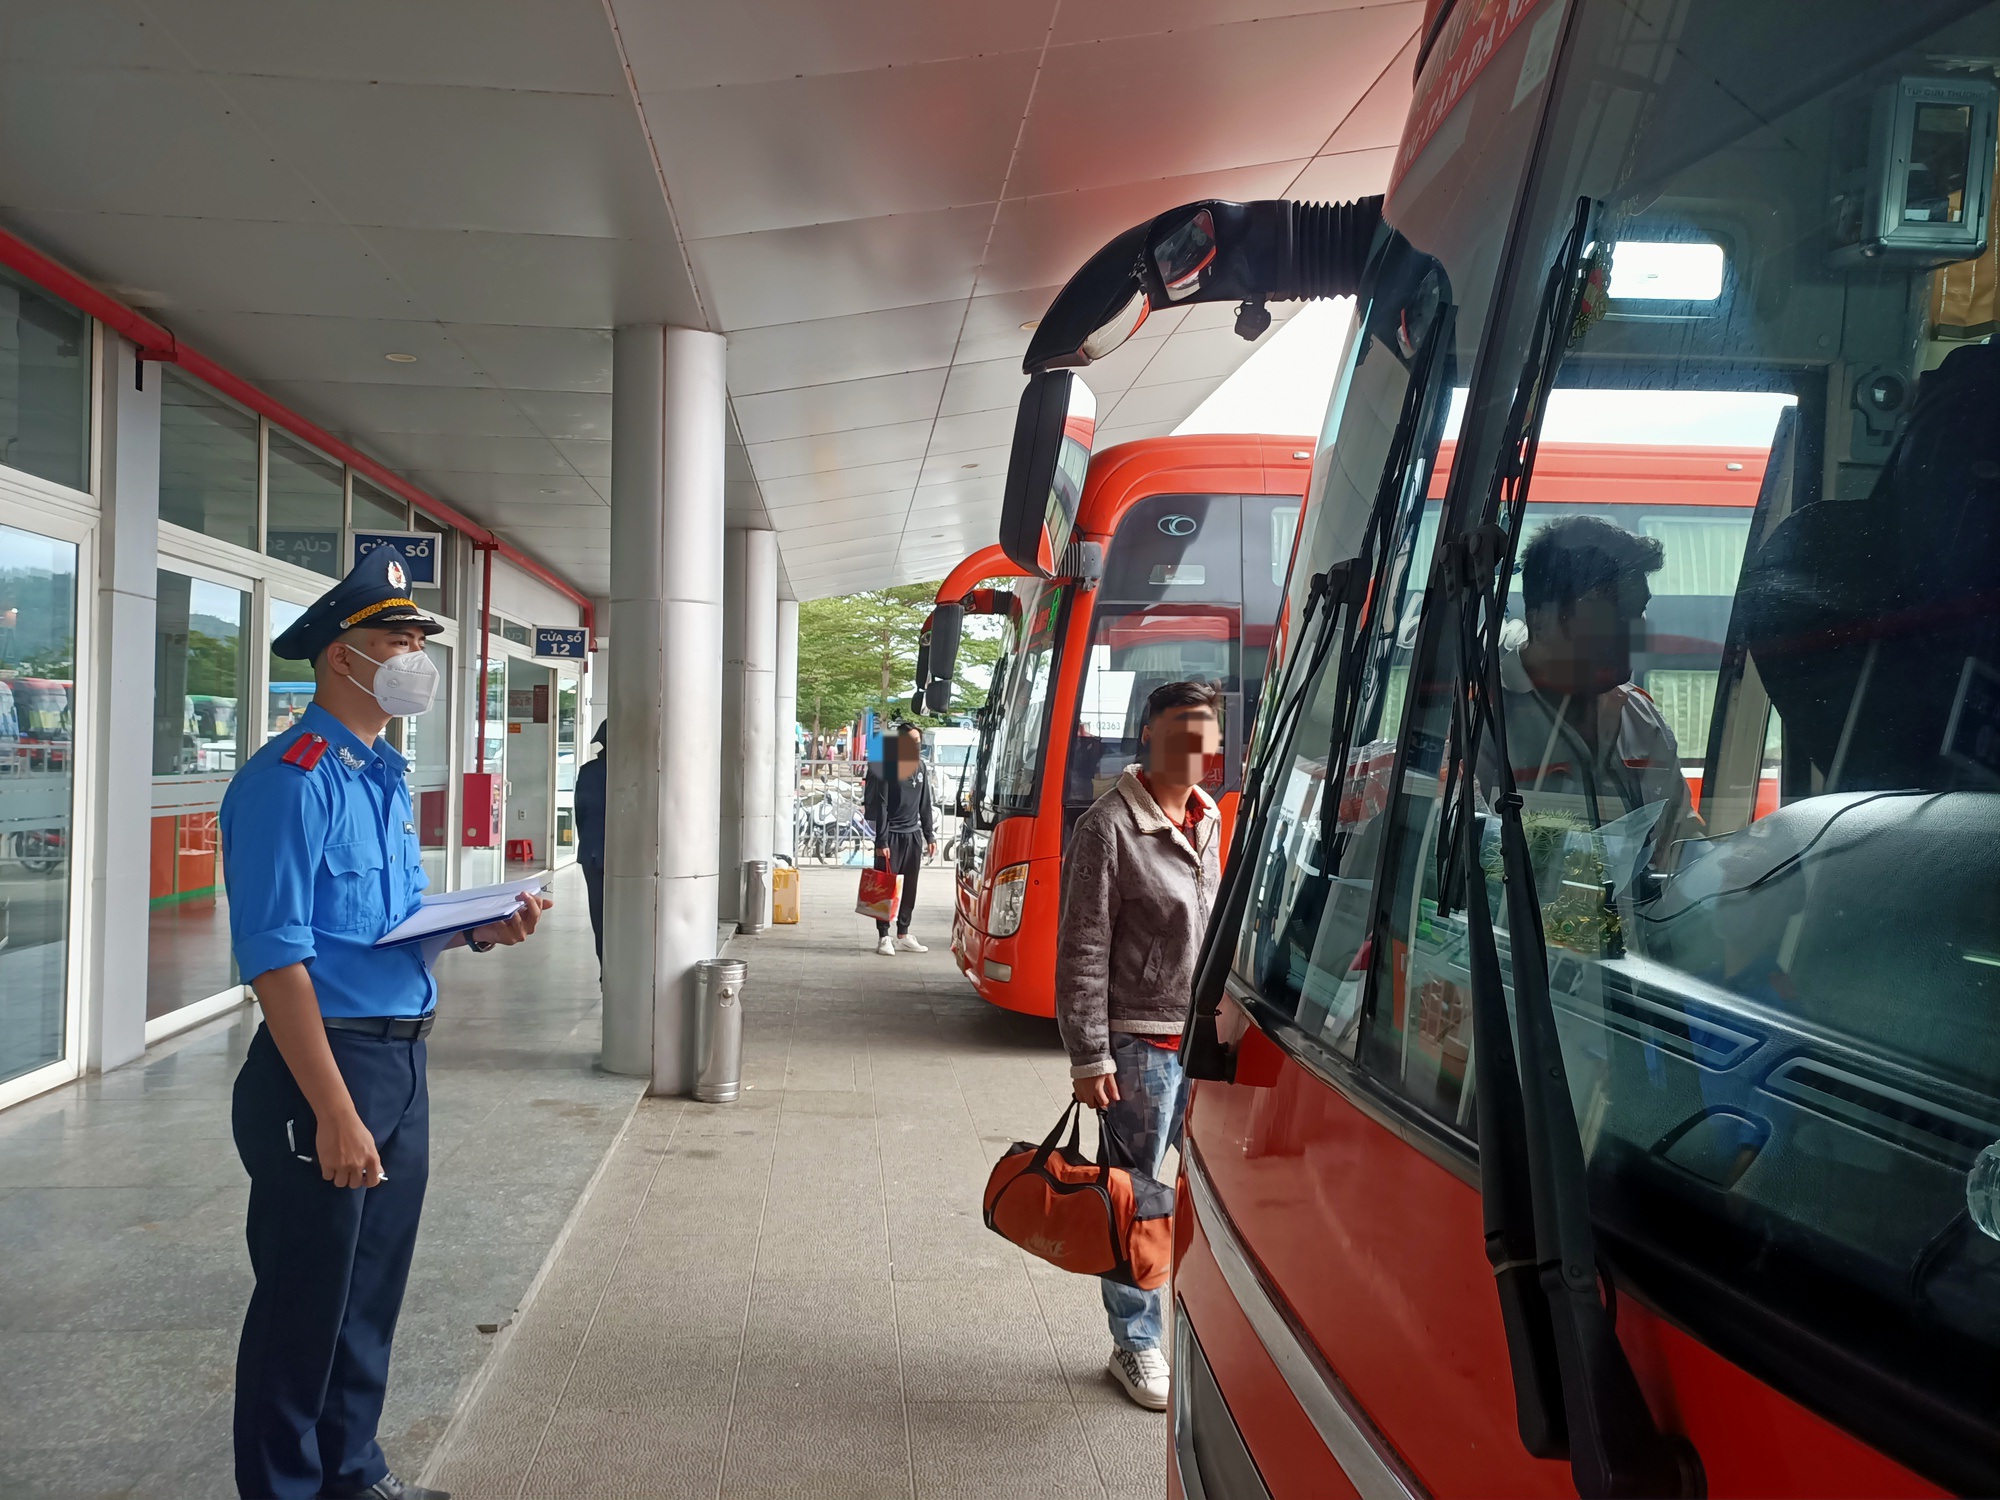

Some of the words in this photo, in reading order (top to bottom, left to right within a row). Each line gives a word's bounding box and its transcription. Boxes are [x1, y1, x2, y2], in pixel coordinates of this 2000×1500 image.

[405, 540, 429, 557] SỐ
[540, 631, 564, 642] CỬA
[567, 632, 582, 643] SỐ
[551, 643, 570, 655] 12
